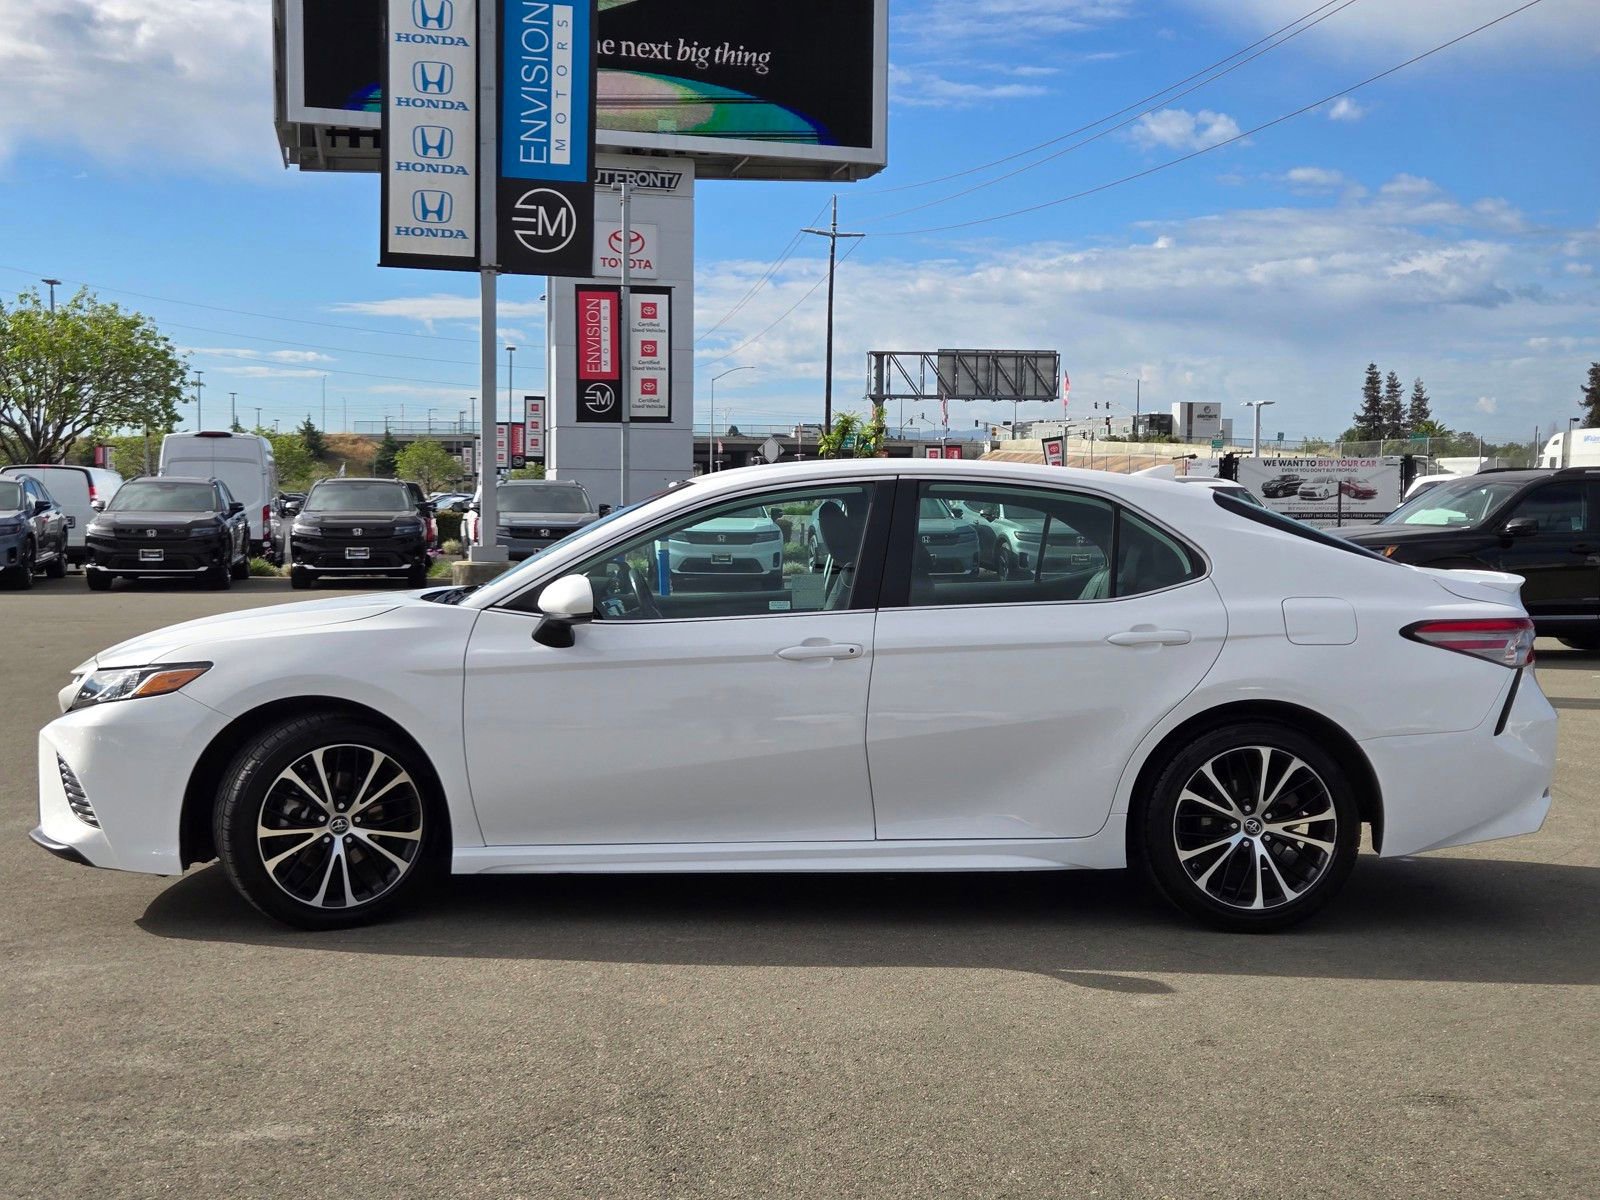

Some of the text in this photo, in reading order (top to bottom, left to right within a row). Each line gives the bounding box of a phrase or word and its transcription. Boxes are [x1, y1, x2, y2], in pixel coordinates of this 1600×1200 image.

[395, 32, 470, 47] HONDA
[620, 40, 672, 60] next
[676, 38, 711, 70] big
[714, 42, 771, 75] thing
[519, 1, 550, 164] ENVISION
[555, 19, 569, 152] MOTORS
[395, 97, 470, 111] HONDA
[395, 161, 470, 176] HONDA
[395, 226, 470, 240] HONDA
[600, 257, 653, 269] TOOTA
[586, 298, 600, 373] ENVISION
[1360, 460, 1377, 468] CAR
